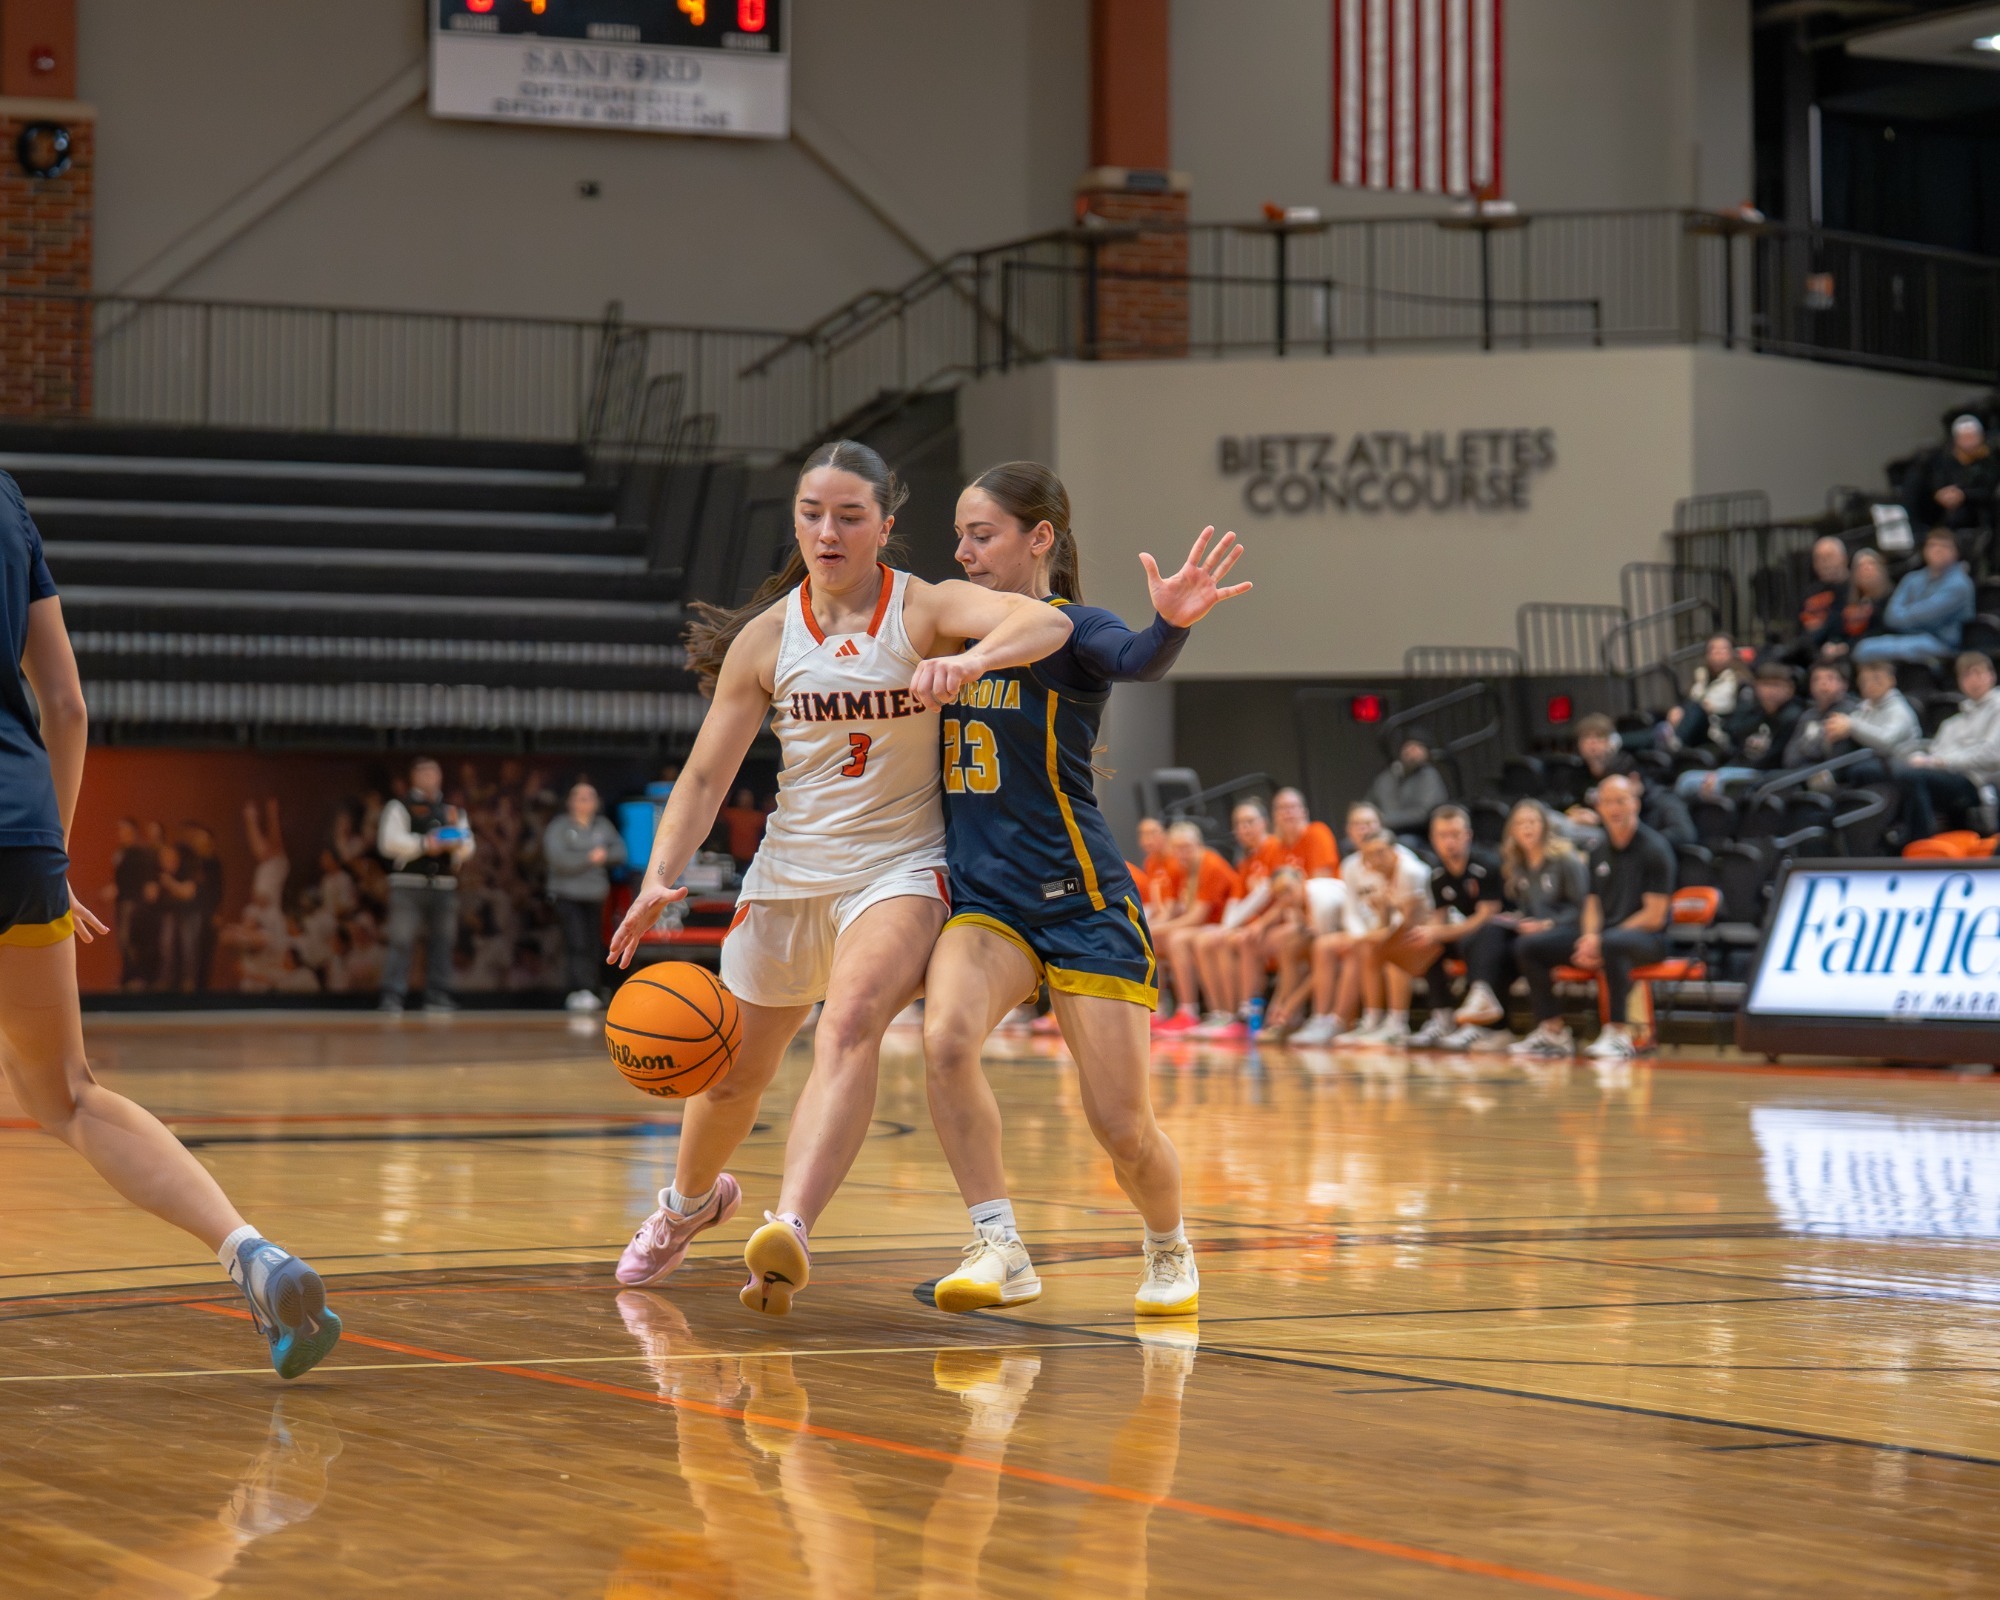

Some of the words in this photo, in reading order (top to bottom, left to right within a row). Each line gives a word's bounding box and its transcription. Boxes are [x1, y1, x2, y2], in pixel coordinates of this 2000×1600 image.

[522, 46, 703, 84] SANFORD
[1218, 431, 1336, 473] BIETZ
[1346, 428, 1557, 474] ATHLETES
[1243, 466, 1530, 514] CONCOURSE
[840, 732, 871, 777] 3
[943, 718, 1001, 794] 23
[1778, 871, 2000, 979] Fairfie
[1893, 989, 1925, 1012] BY
[1930, 991, 2000, 1013] MARR
